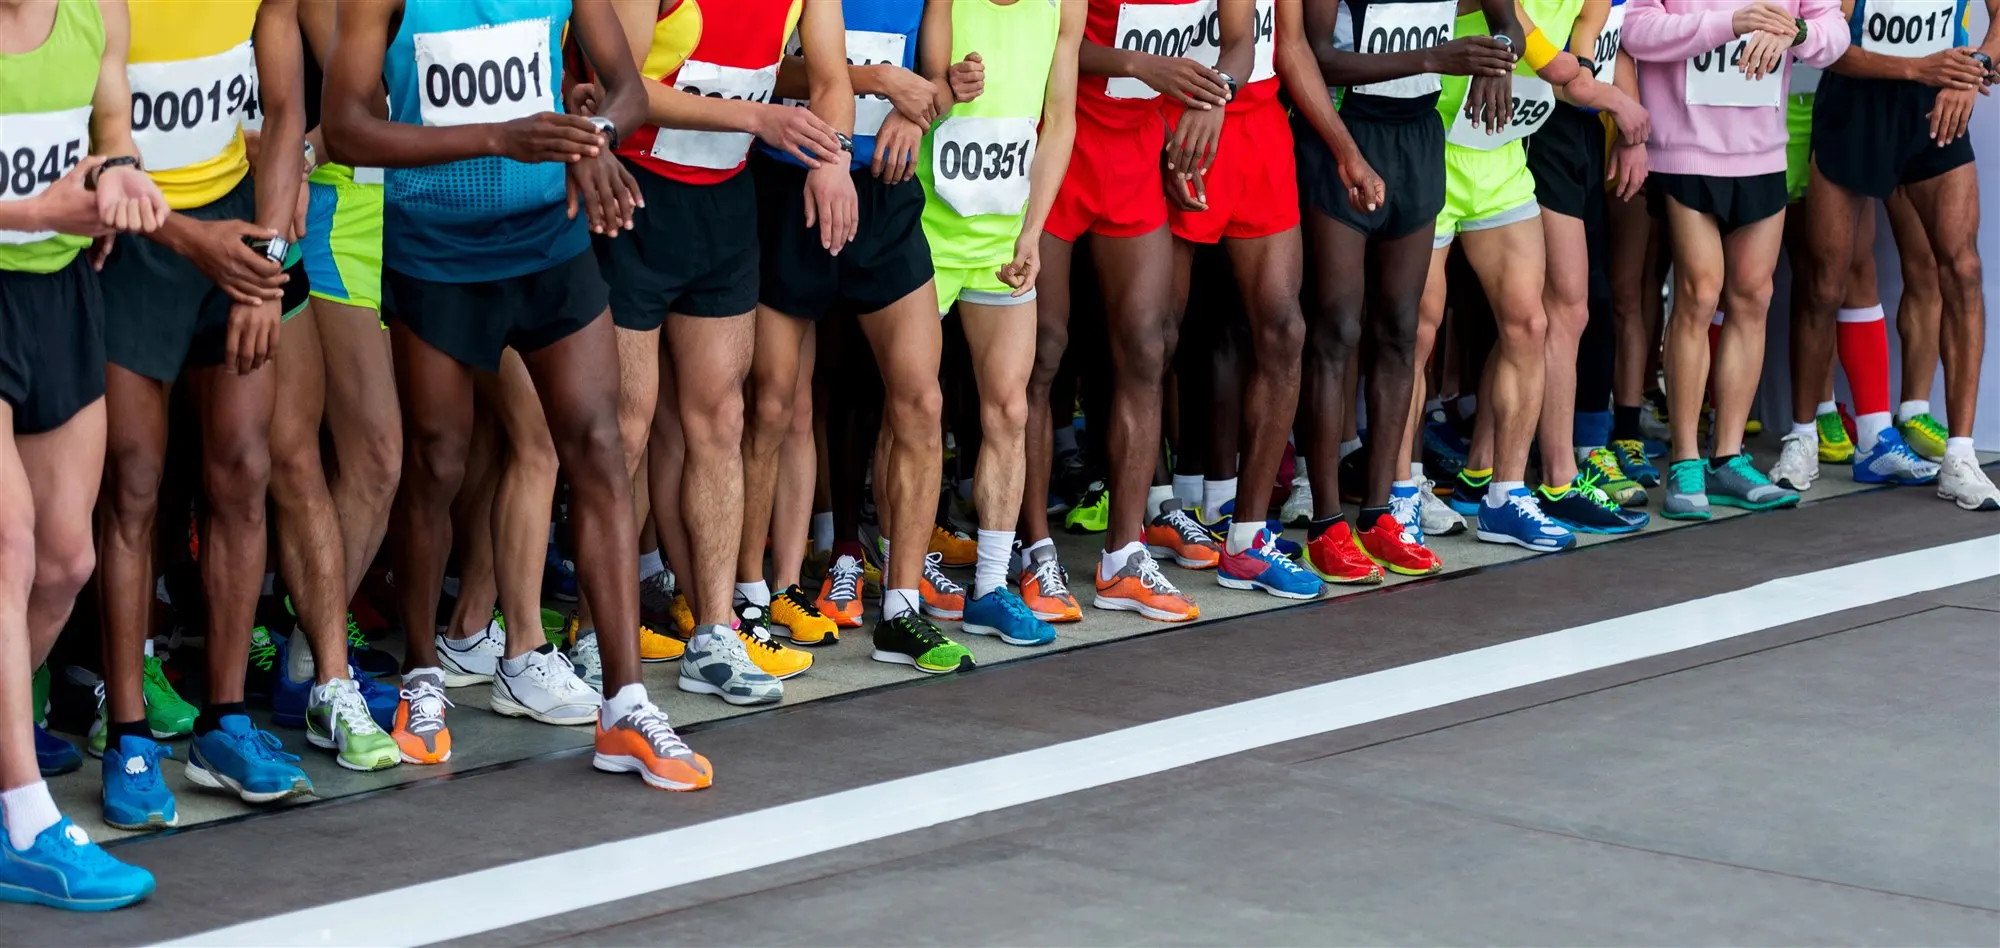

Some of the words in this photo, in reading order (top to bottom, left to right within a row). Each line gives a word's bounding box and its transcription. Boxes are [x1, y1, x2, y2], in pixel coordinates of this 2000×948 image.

[1868, 6, 1953, 44] 00017
[426, 52, 542, 108] 00001
[940, 140, 1030, 180] 00351
